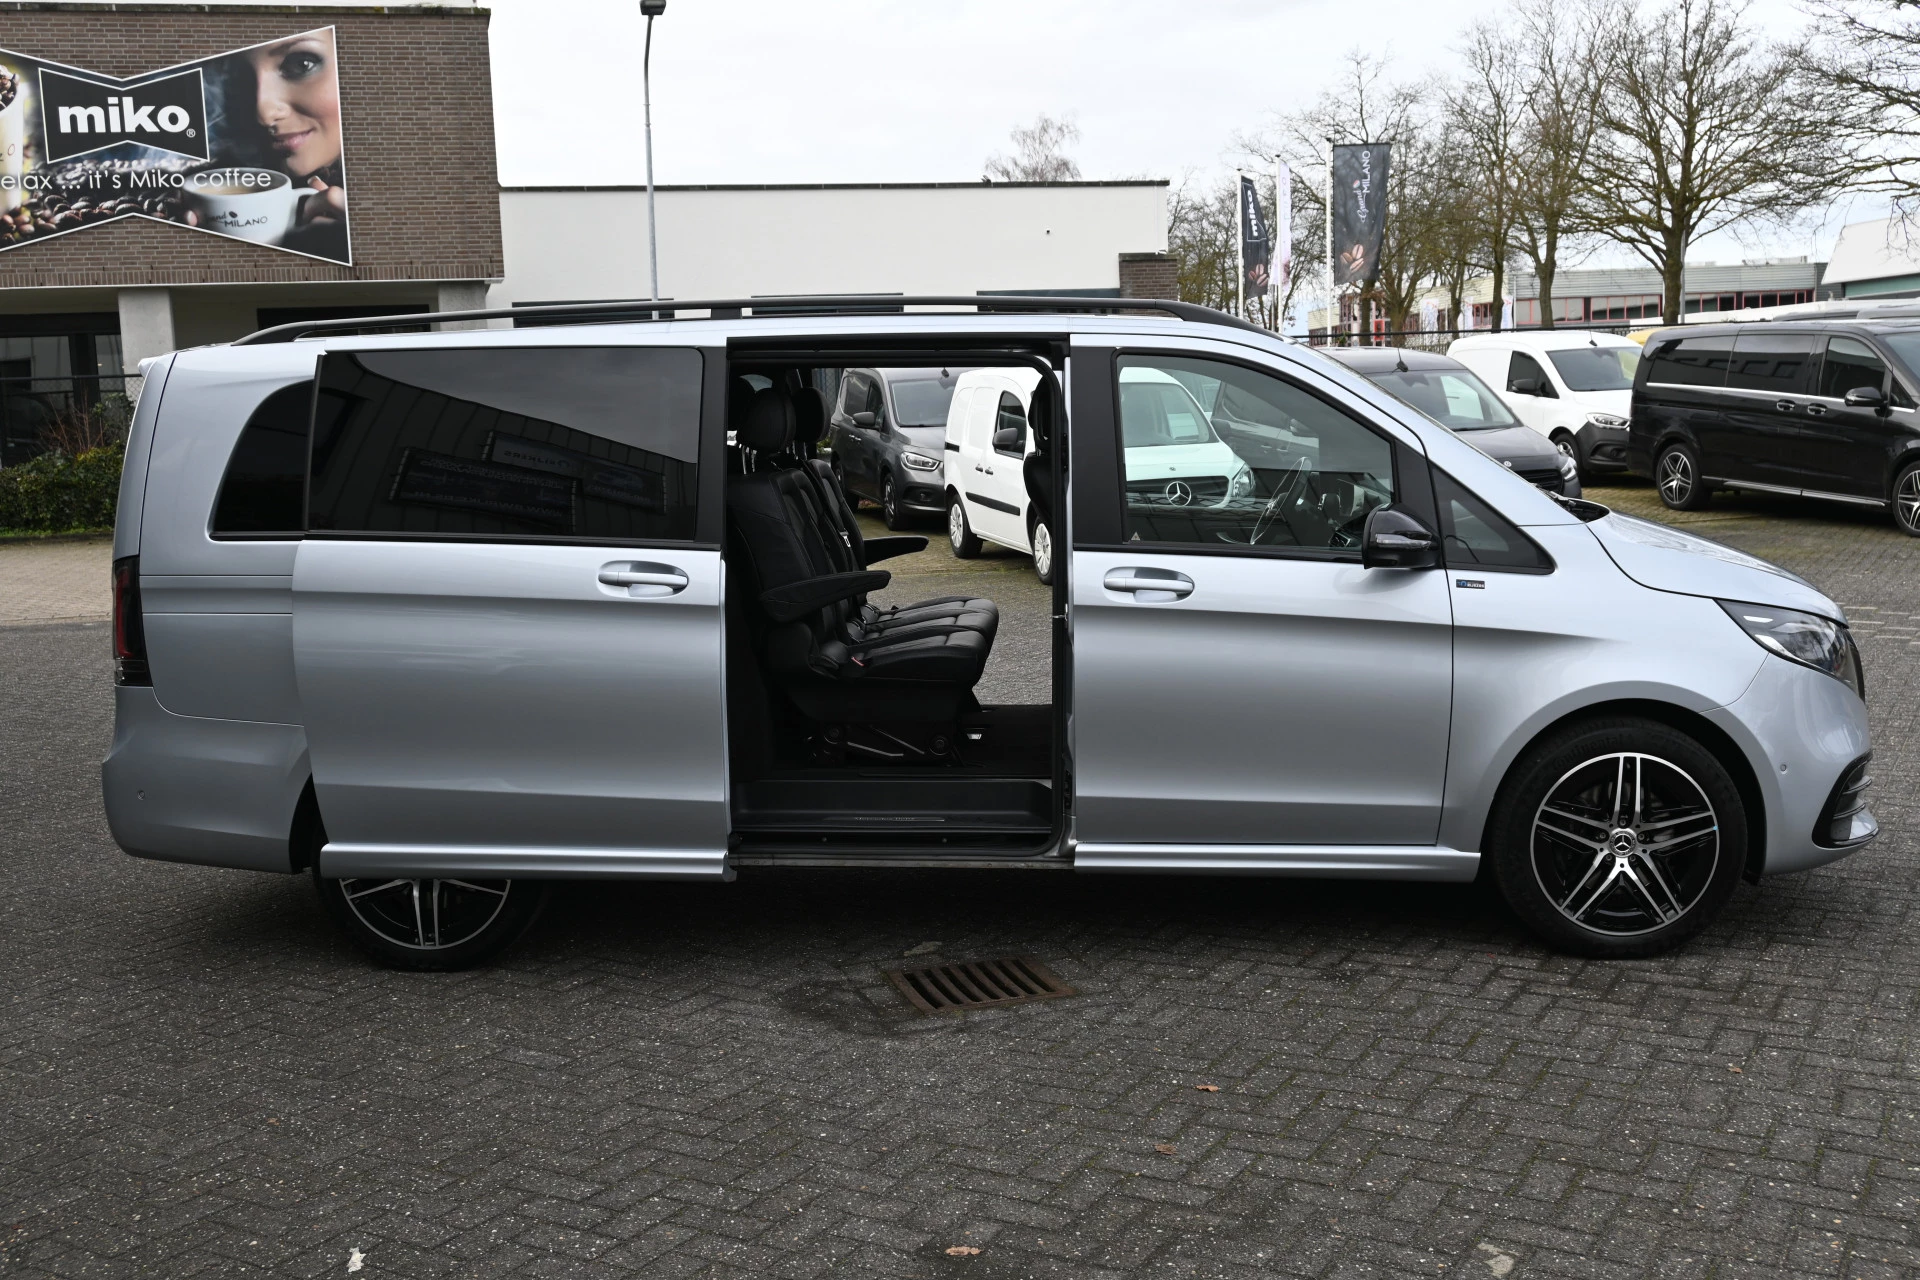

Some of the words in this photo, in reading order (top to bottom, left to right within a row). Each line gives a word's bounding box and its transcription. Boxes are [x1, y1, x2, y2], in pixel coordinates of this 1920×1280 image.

[58, 96, 190, 133] miko
[88, 169, 122, 189] it's
[130, 168, 185, 189] Miko
[193, 168, 272, 188] coffee
[1362, 150, 1371, 193] MILANO
[224, 215, 268, 227] MILANO
[1247, 189, 1258, 237] miko
[1353, 189, 1369, 224] Grand
